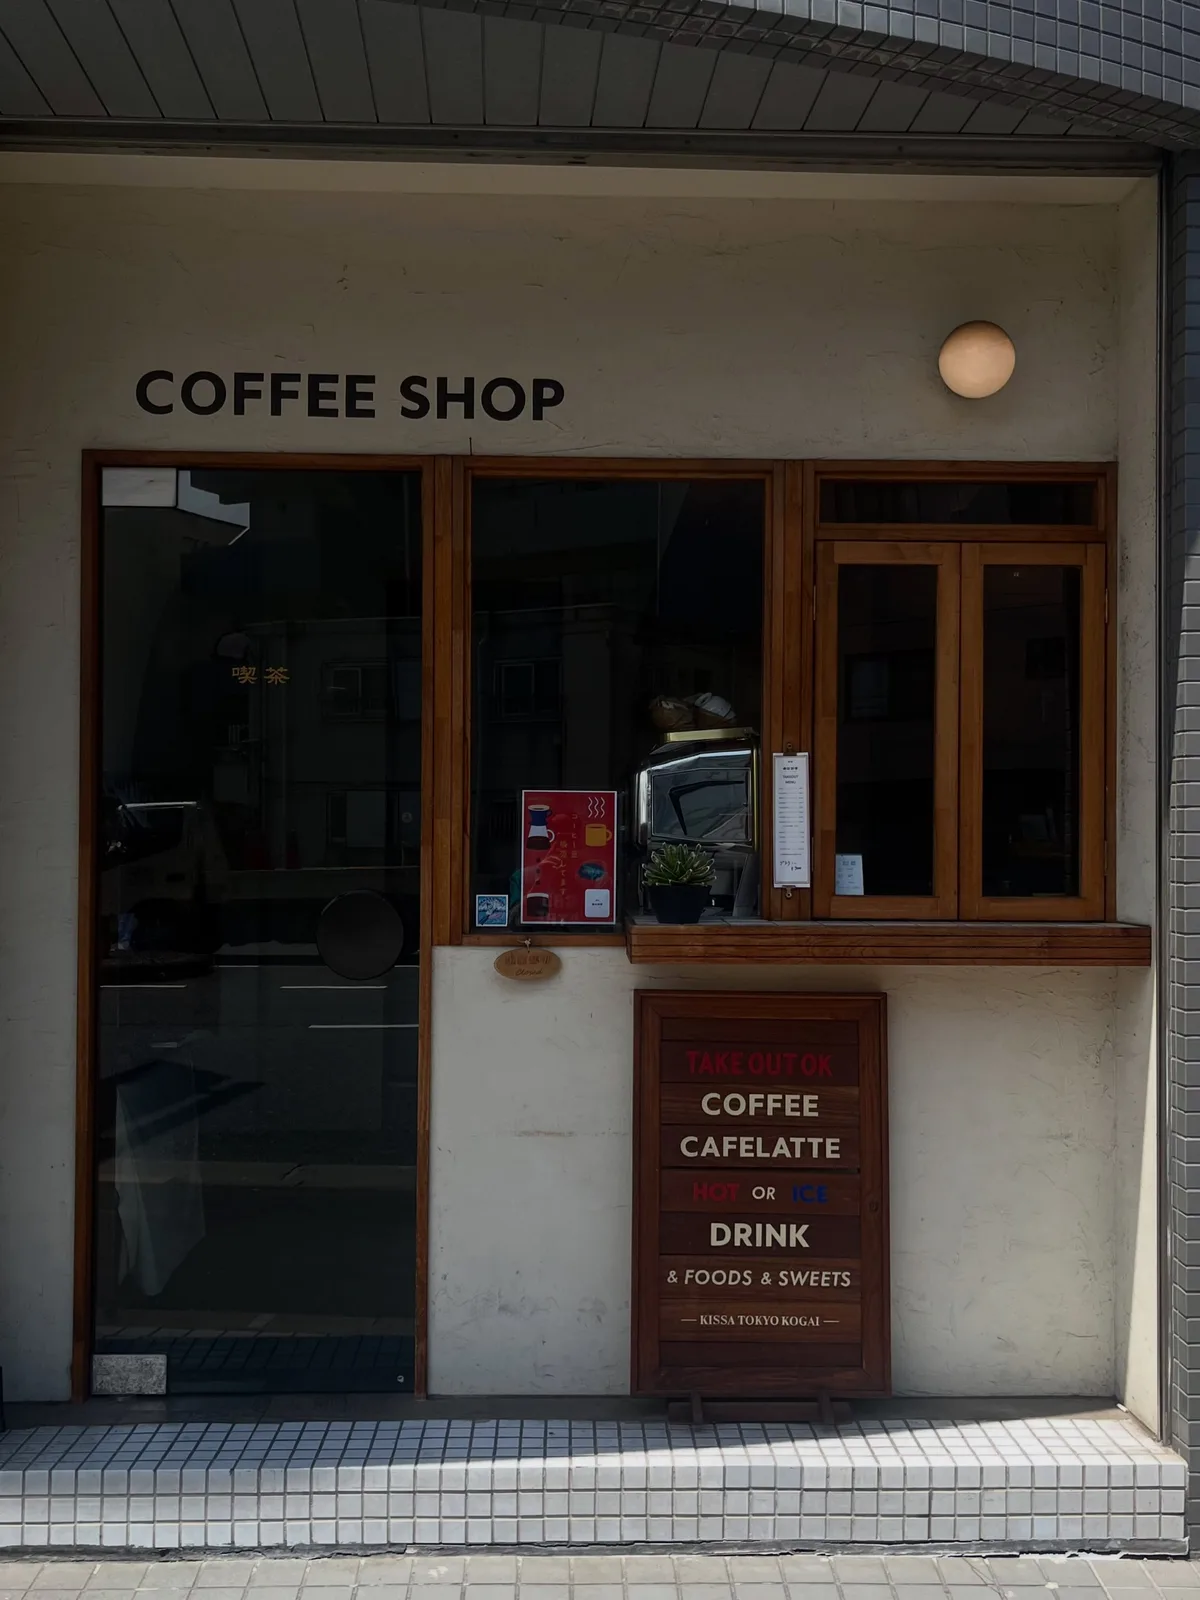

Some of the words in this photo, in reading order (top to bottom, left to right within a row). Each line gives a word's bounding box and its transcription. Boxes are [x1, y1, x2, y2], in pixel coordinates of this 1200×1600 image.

[136, 370, 376, 418] COFFEE
[400, 376, 565, 421] SHOP
[231, 665, 291, 686] 喫茶
[686, 1050, 744, 1075] TAKE
[747, 1051, 798, 1076] OUT
[801, 1053, 833, 1077] OK
[701, 1092, 819, 1117] COFFEE
[680, 1136, 841, 1159] CAFELATTE
[693, 1182, 740, 1202] HOT
[752, 1186, 776, 1200] OR
[792, 1184, 828, 1203] ICE
[710, 1222, 810, 1248] DRINK
[666, 1269, 679, 1284] &
[684, 1269, 752, 1286] FOODS
[760, 1271, 772, 1286] &
[778, 1271, 851, 1287] SWEETS
[700, 1314, 735, 1326] KISSA
[738, 1314, 779, 1327] TOKYO
[781, 1315, 820, 1327] KOGAI
